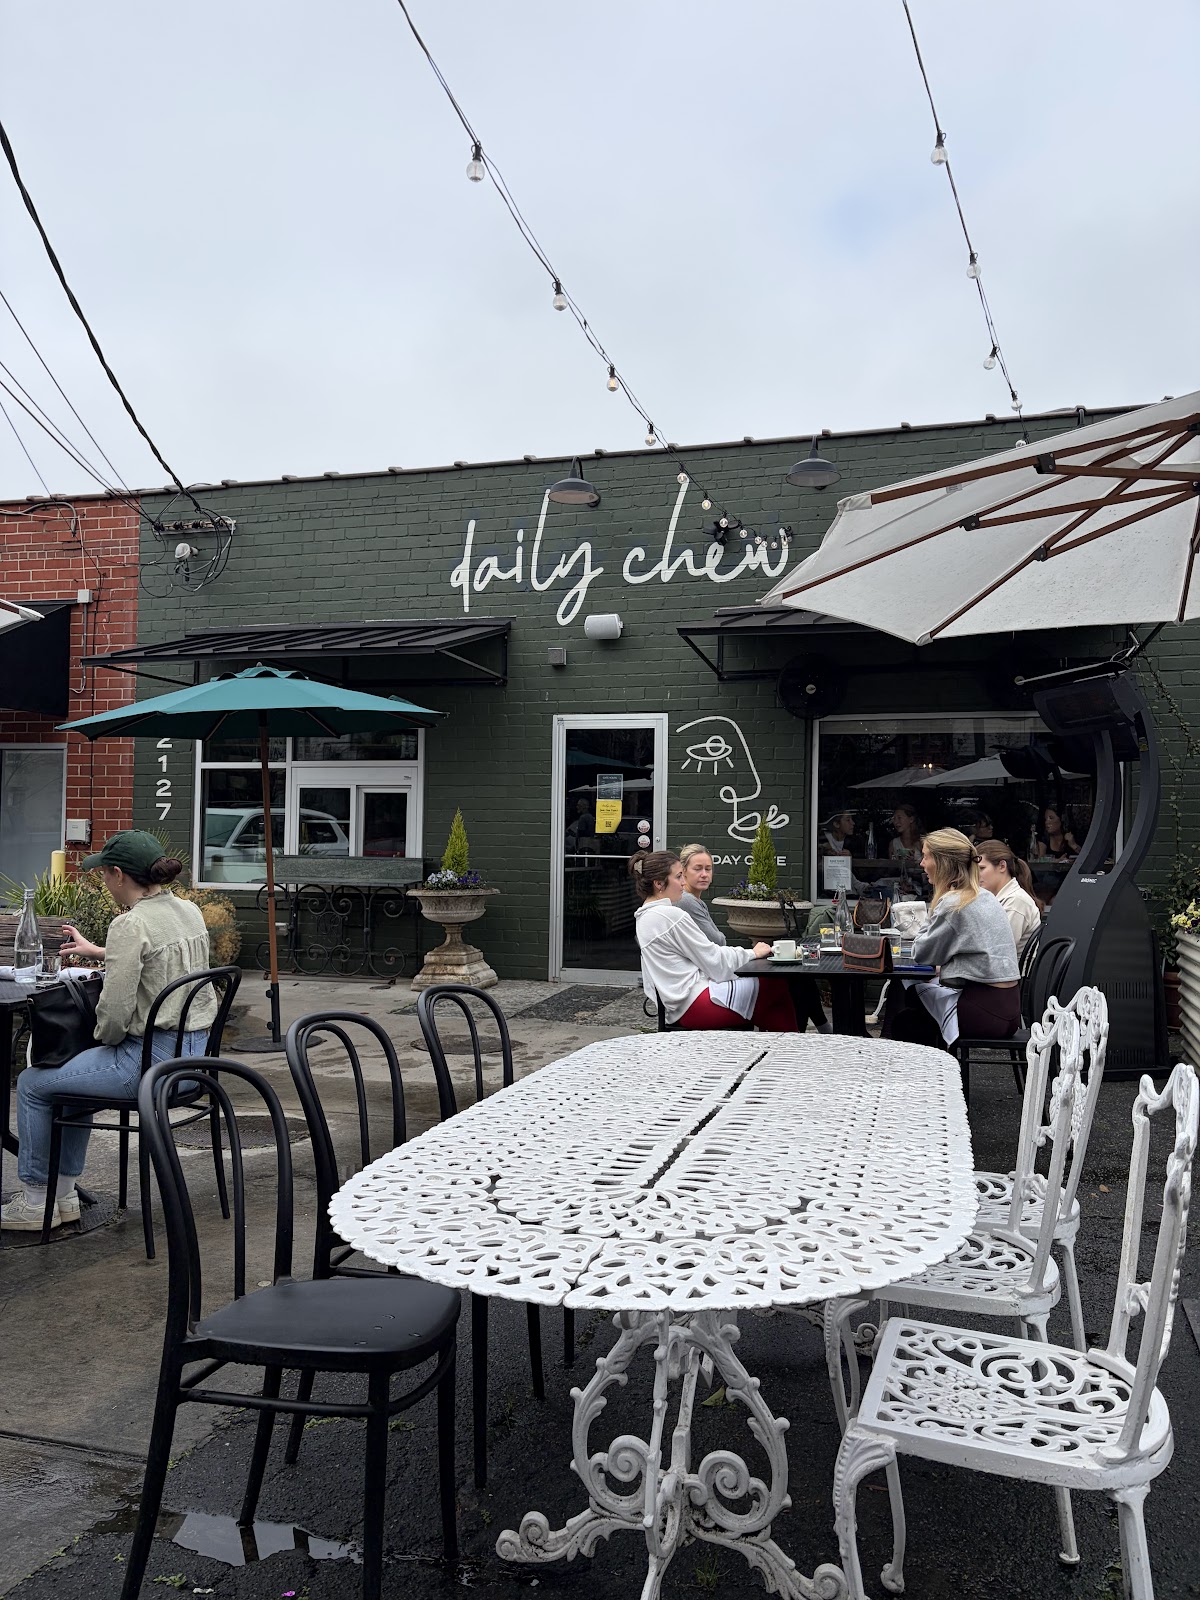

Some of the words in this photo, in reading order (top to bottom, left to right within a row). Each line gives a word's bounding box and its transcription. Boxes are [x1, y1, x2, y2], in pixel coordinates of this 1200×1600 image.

[450, 488, 604, 626] daily
[622, 477, 789, 583] chew
[711, 855, 741, 865] DAY
[744, 855, 787, 866] CE
